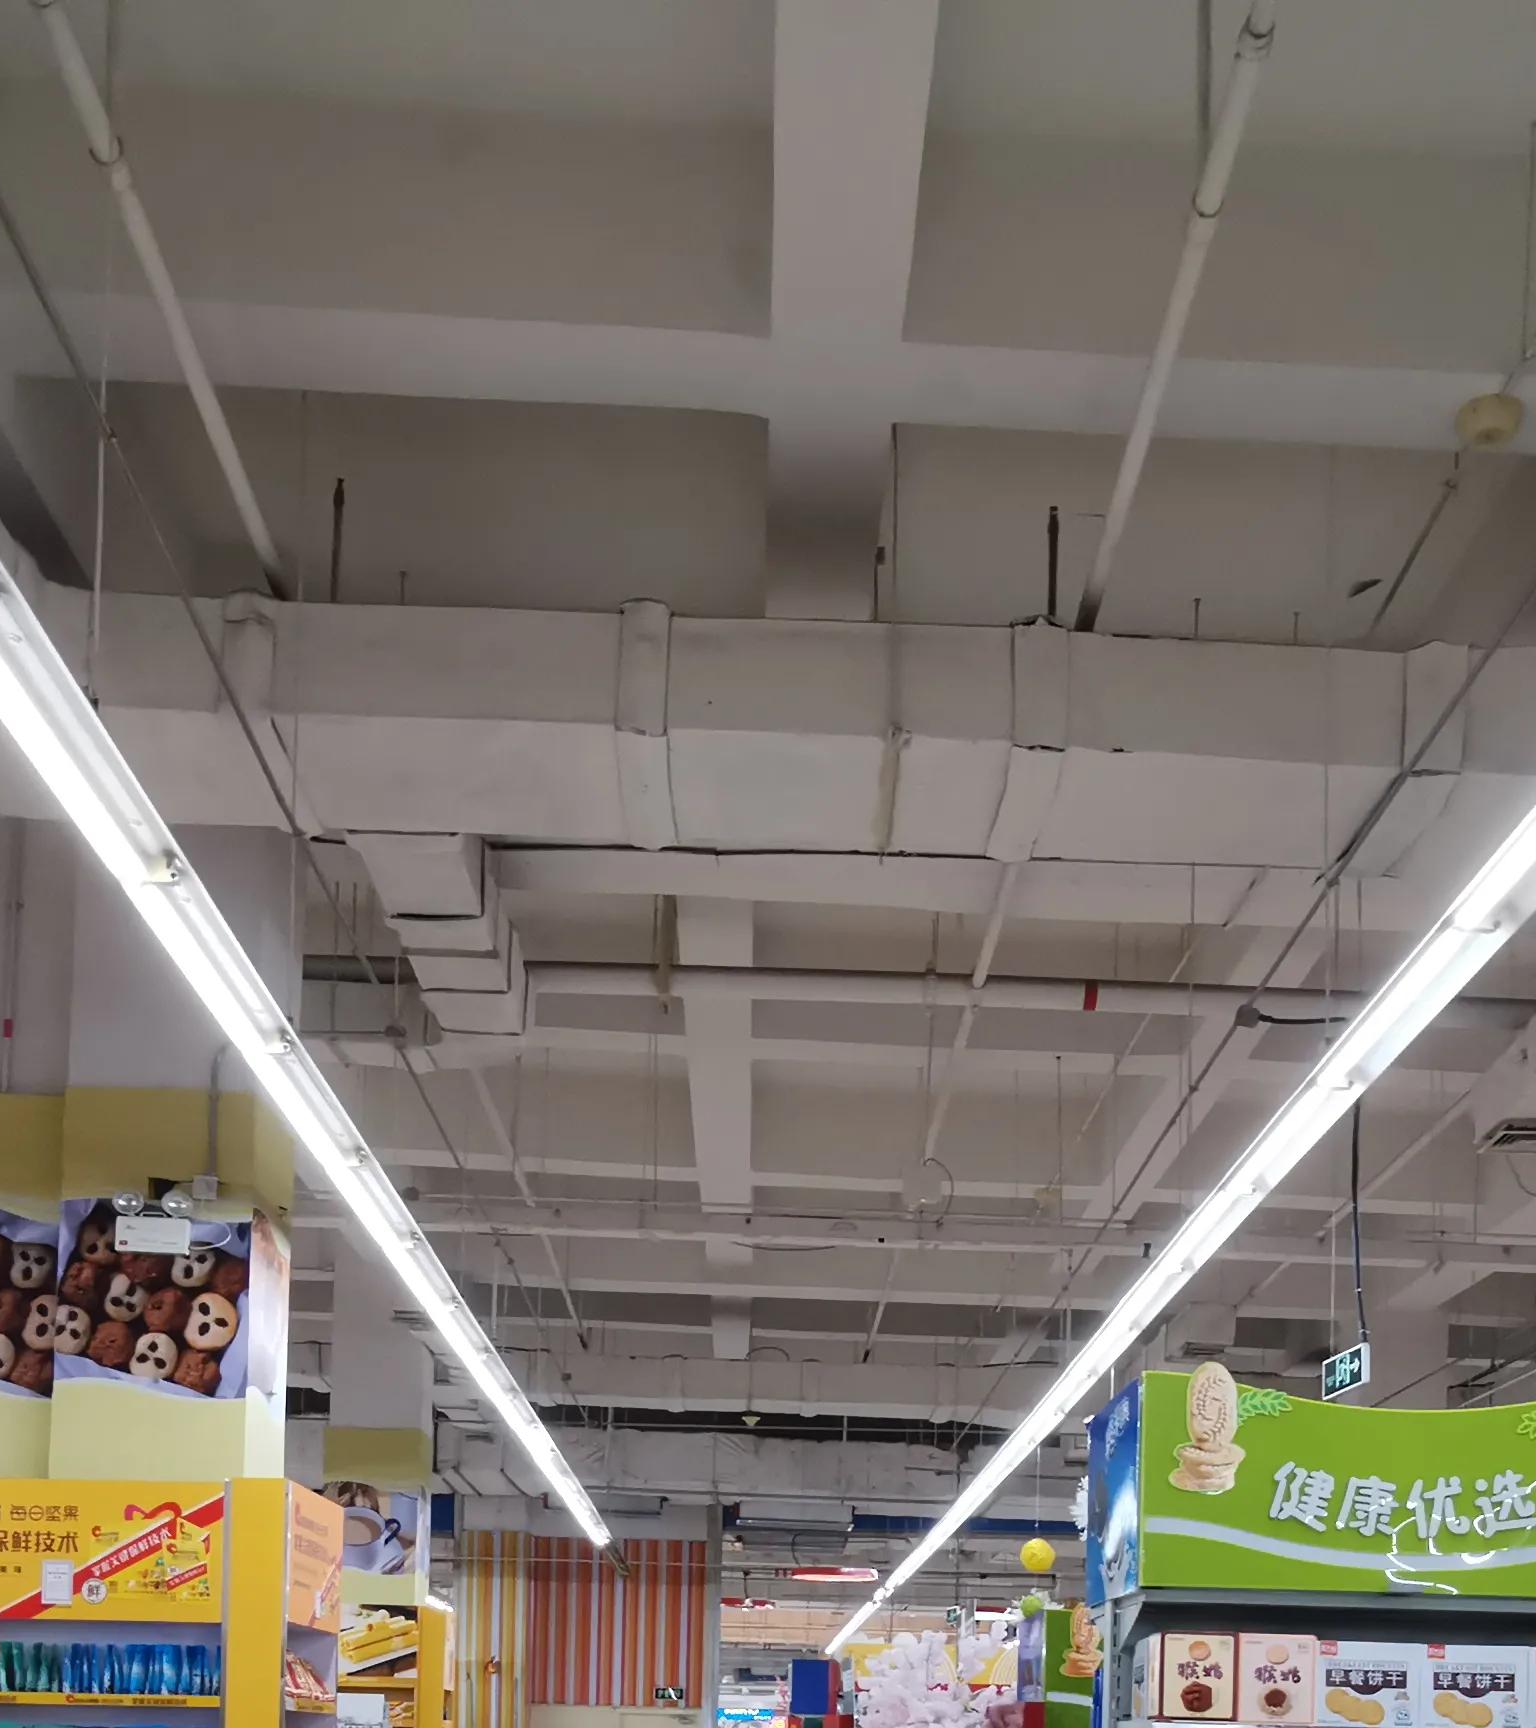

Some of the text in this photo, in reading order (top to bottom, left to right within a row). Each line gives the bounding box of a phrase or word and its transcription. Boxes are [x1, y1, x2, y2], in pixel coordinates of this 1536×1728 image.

[1328, 1670, 1405, 1688] 早餐饼干
[1437, 1672, 1512, 1690] 早餐饼干
